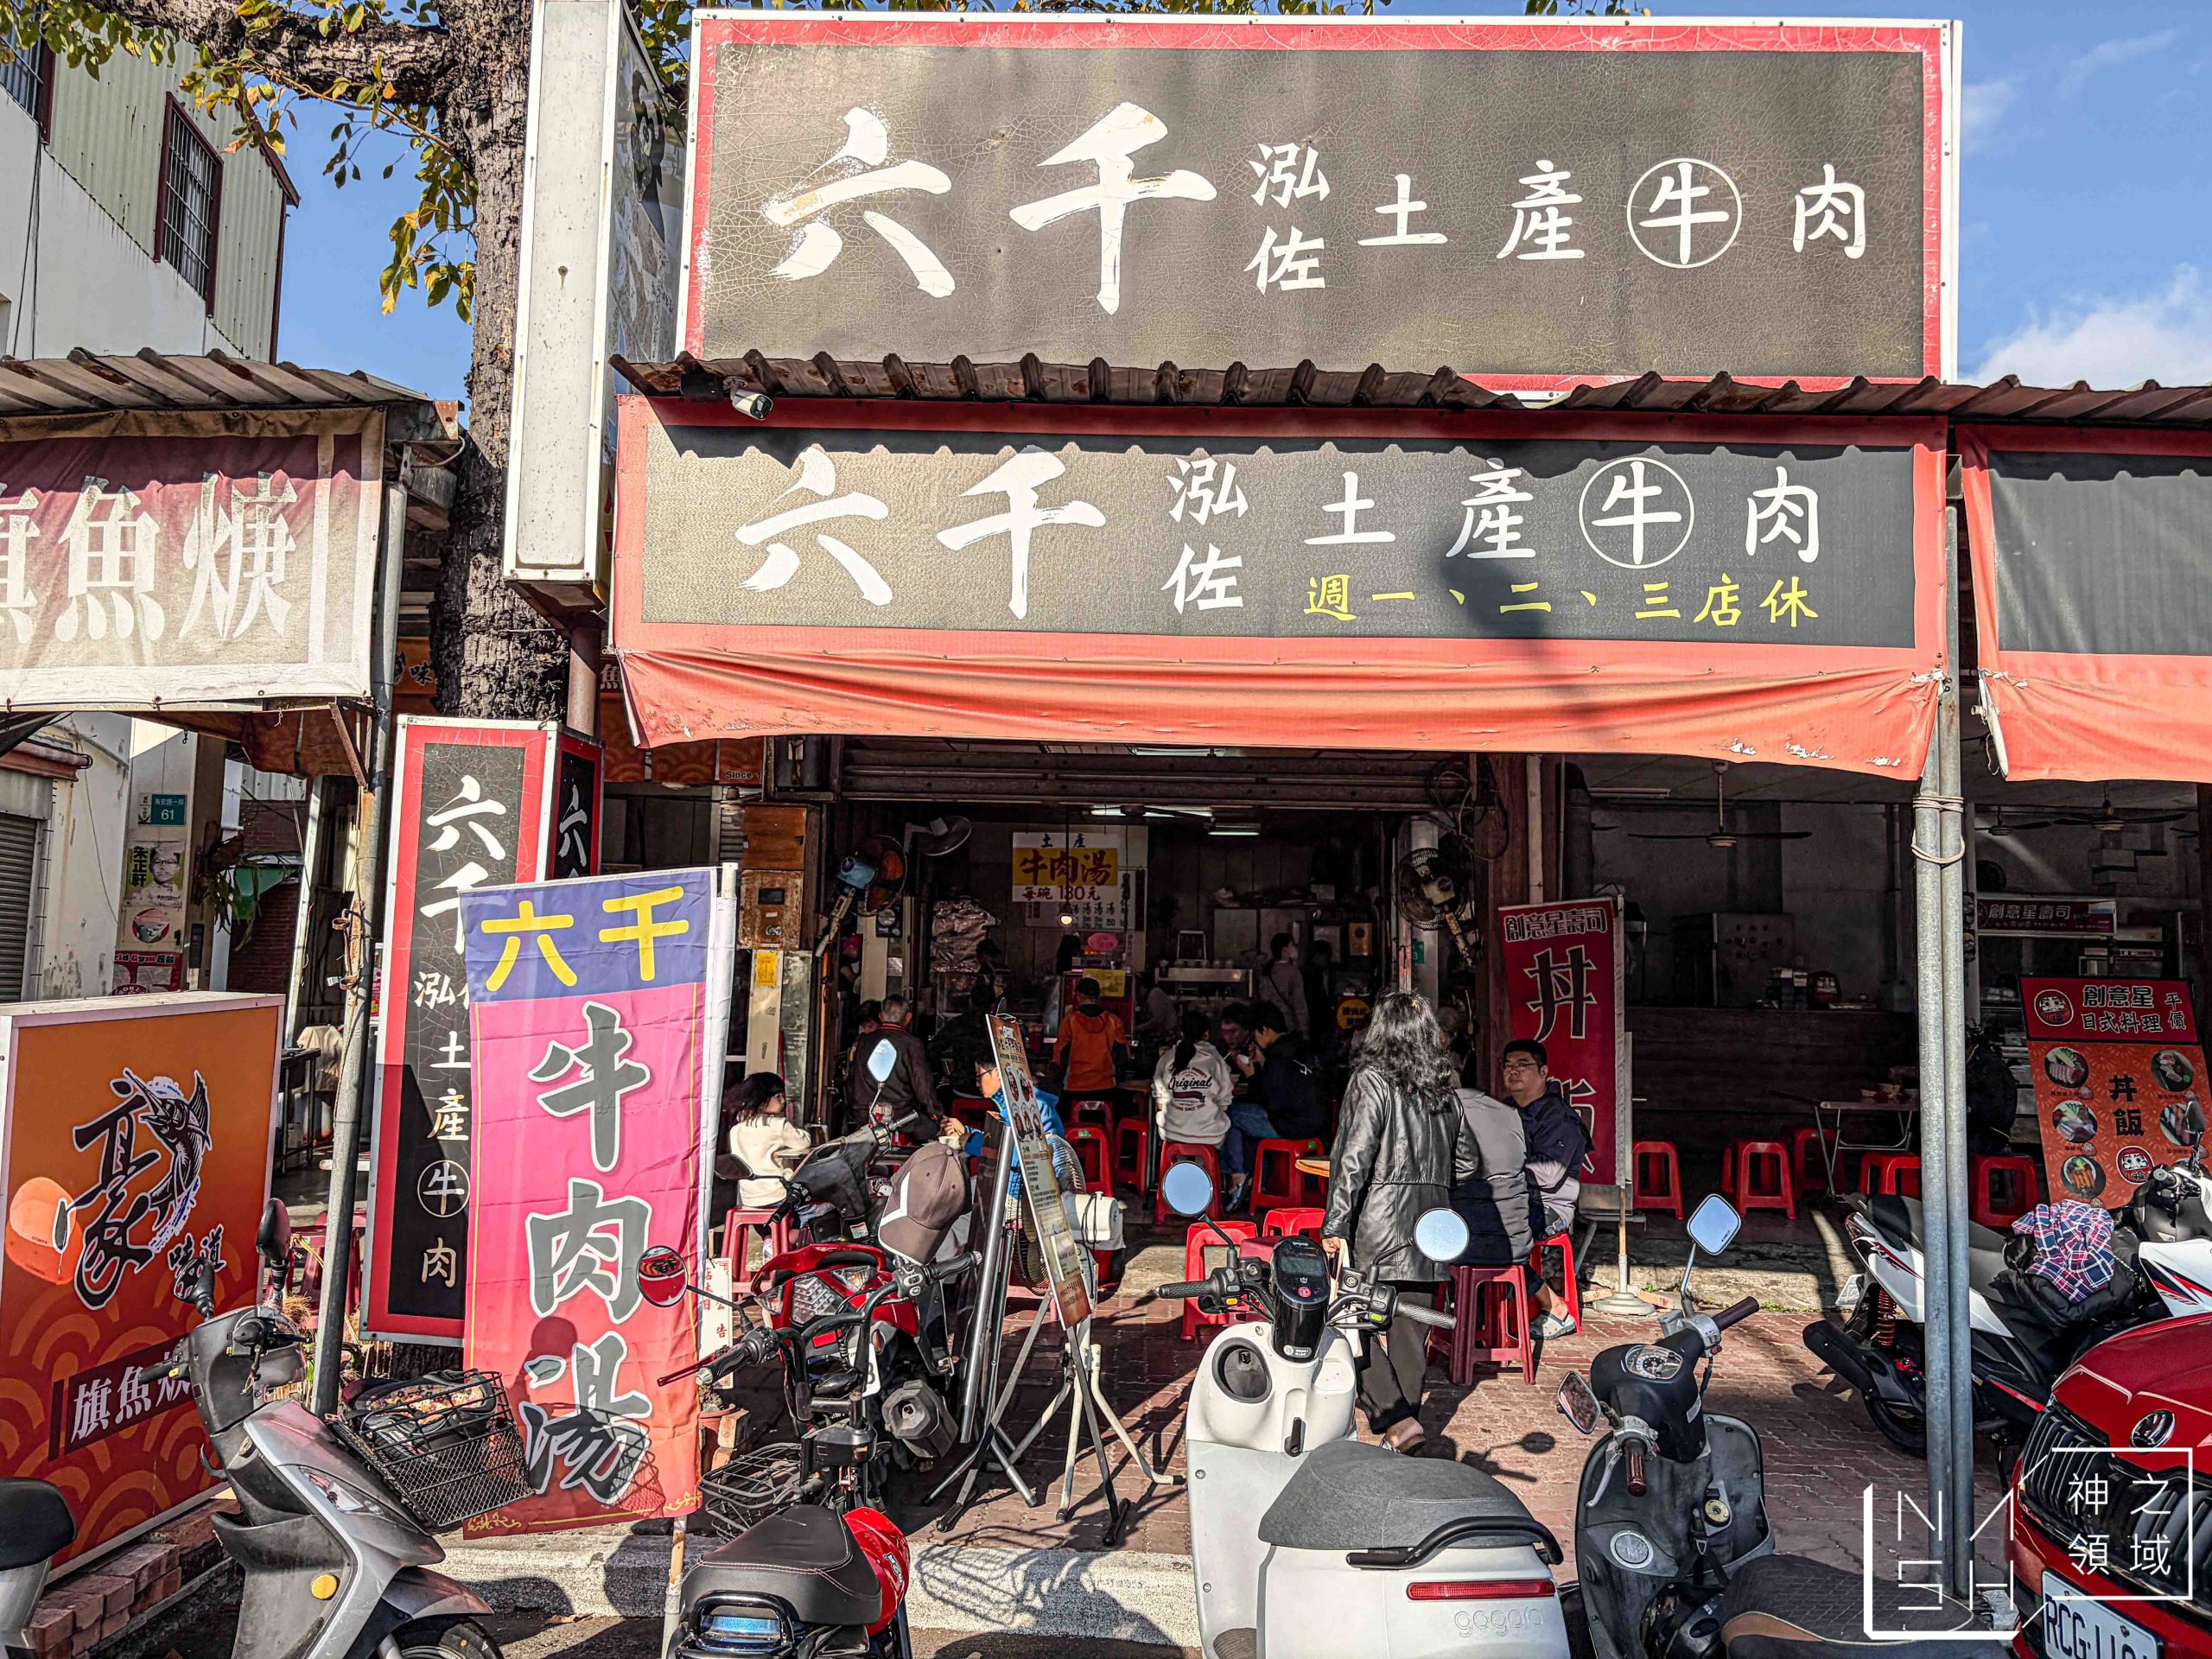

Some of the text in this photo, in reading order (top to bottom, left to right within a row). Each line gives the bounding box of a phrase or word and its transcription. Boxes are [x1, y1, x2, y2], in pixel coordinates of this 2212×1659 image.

[762, 102, 1217, 315] 六千
[735, 445, 1106, 620] 六千
[1304, 574, 1819, 628] 週一、二、三店休
[162, 810, 175, 820] 61
[557, 785, 588, 878] 六
[131, 846, 149, 887] 朱正軒
[1020, 849, 1111, 886] 牛肉湯
[1504, 908, 1608, 942] 創意星壽司
[1988, 904, 2071, 920] 創意星壽司
[480, 886, 689, 992] 六千
[130, 955, 156, 963] Gym
[414, 971, 469, 1009] 泓
[2083, 985, 2154, 1008] 創意星
[2082, 1011, 2163, 1033] 日式料理
[2164, 993, 2187, 1030] 平價
[1168, 1076, 1212, 1090] Original
[2109, 1074, 2145, 1136] 丼飯
[518, 1001, 652, 1505] 牛肉湯
